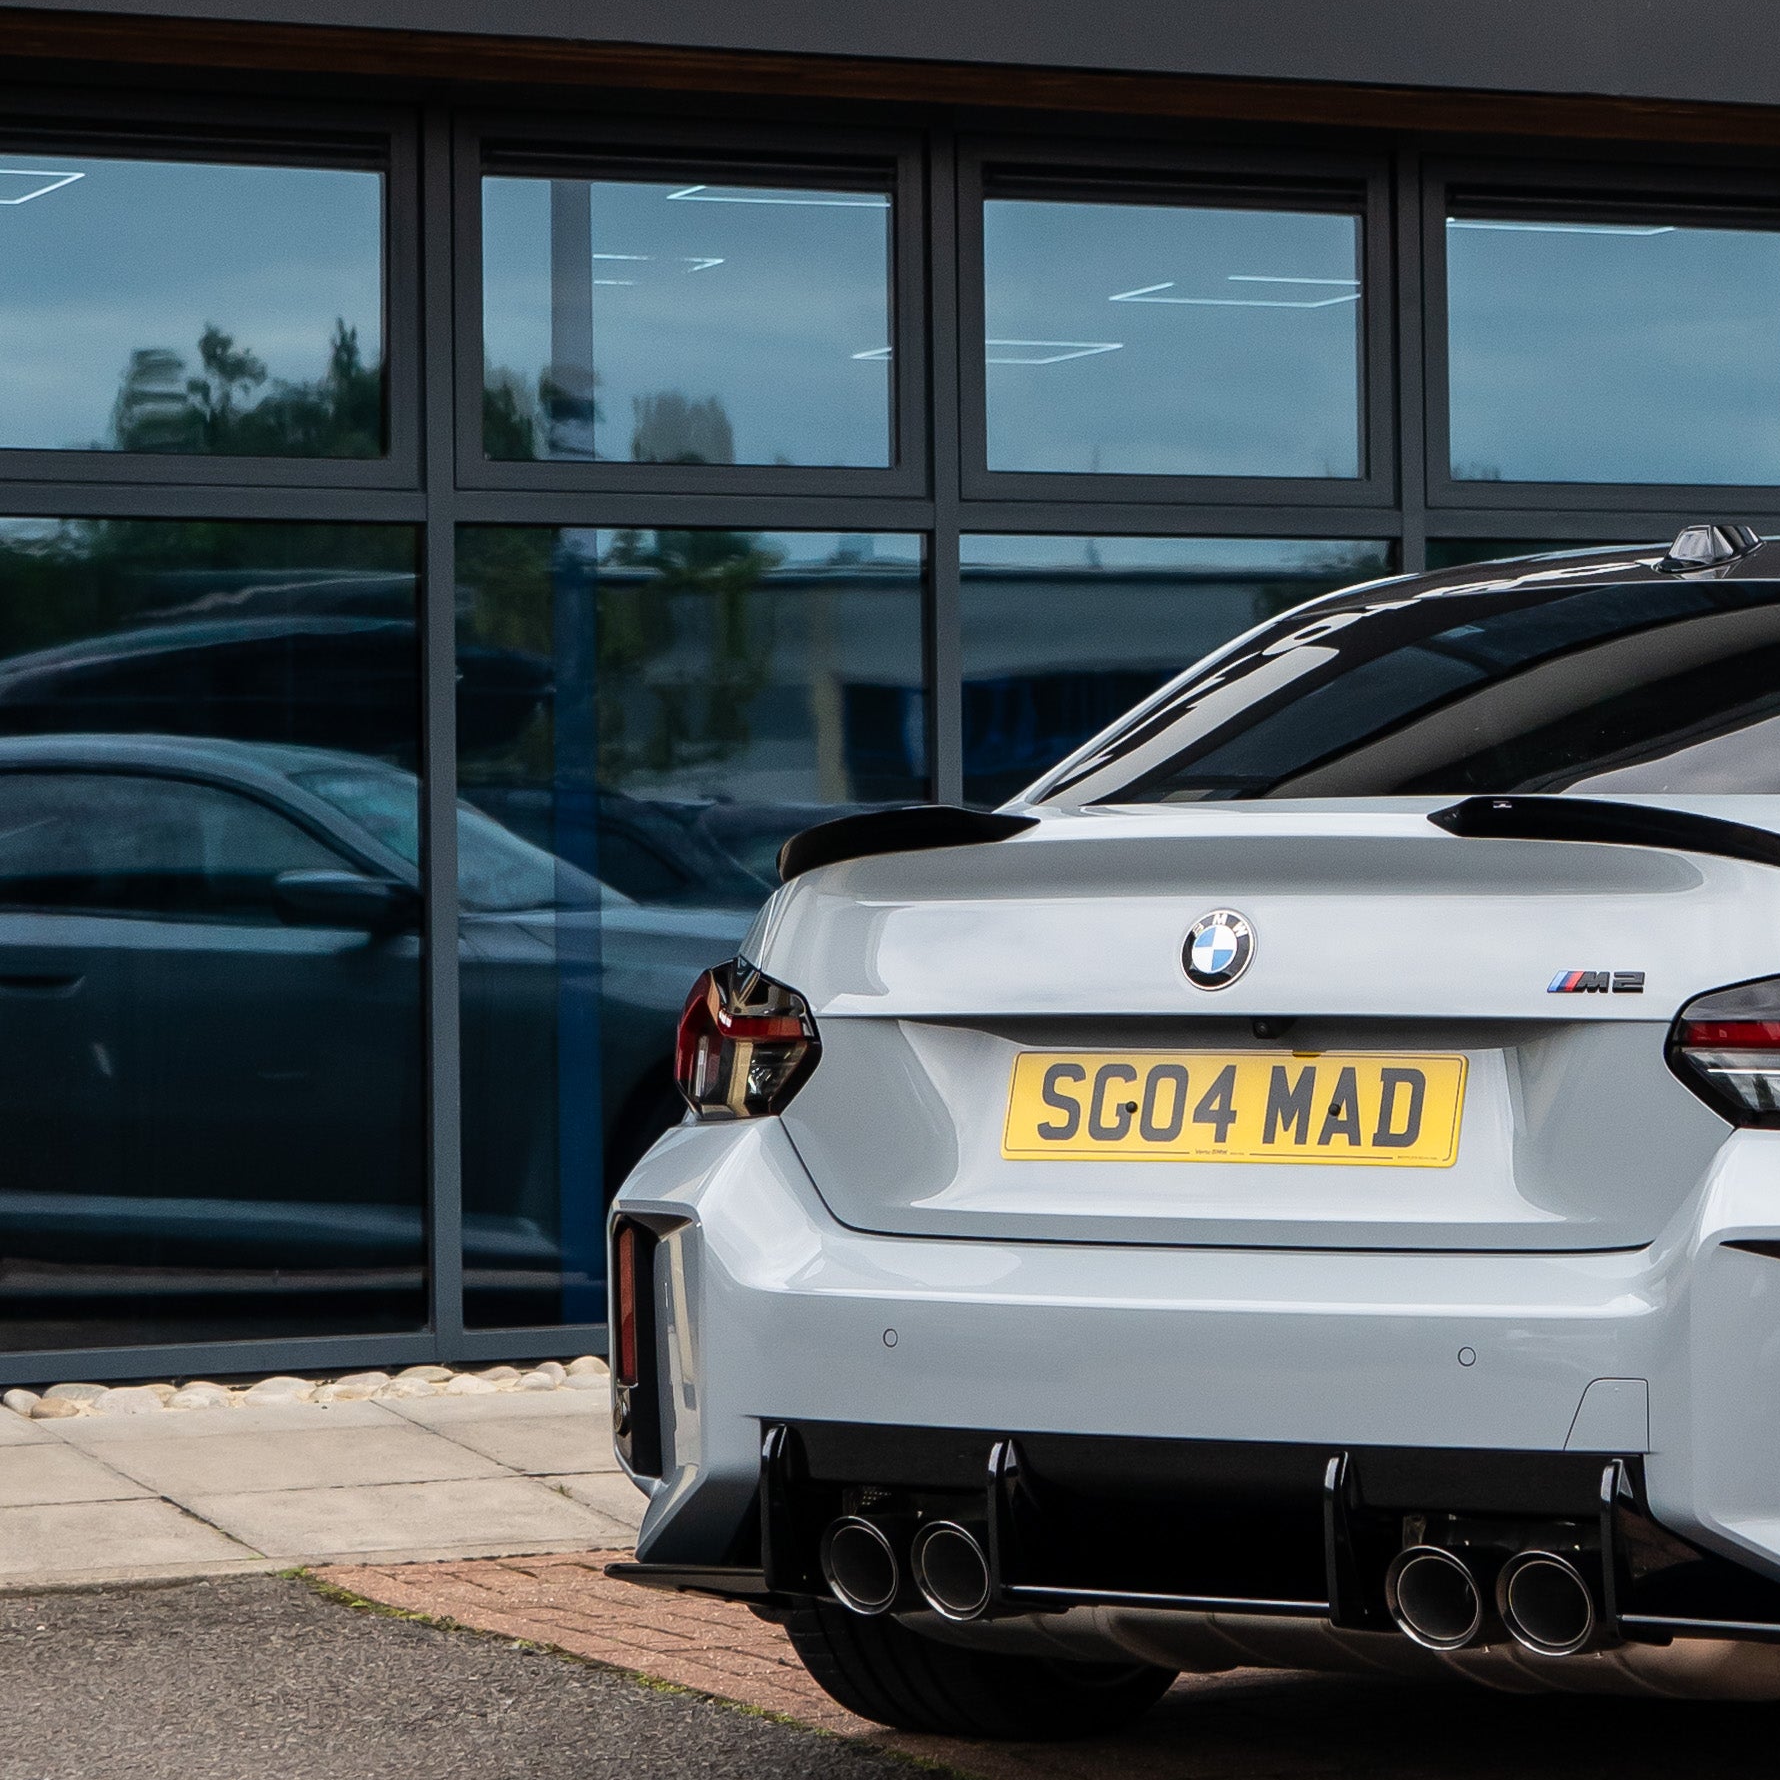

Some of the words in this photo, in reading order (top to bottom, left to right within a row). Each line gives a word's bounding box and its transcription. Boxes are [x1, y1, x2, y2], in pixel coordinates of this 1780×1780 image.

[1192, 913, 1249, 938] BMW
[1574, 971, 1645, 993] M2
[1037, 1063, 1237, 1143] SG04
[1262, 1065, 1427, 1148] MAD
